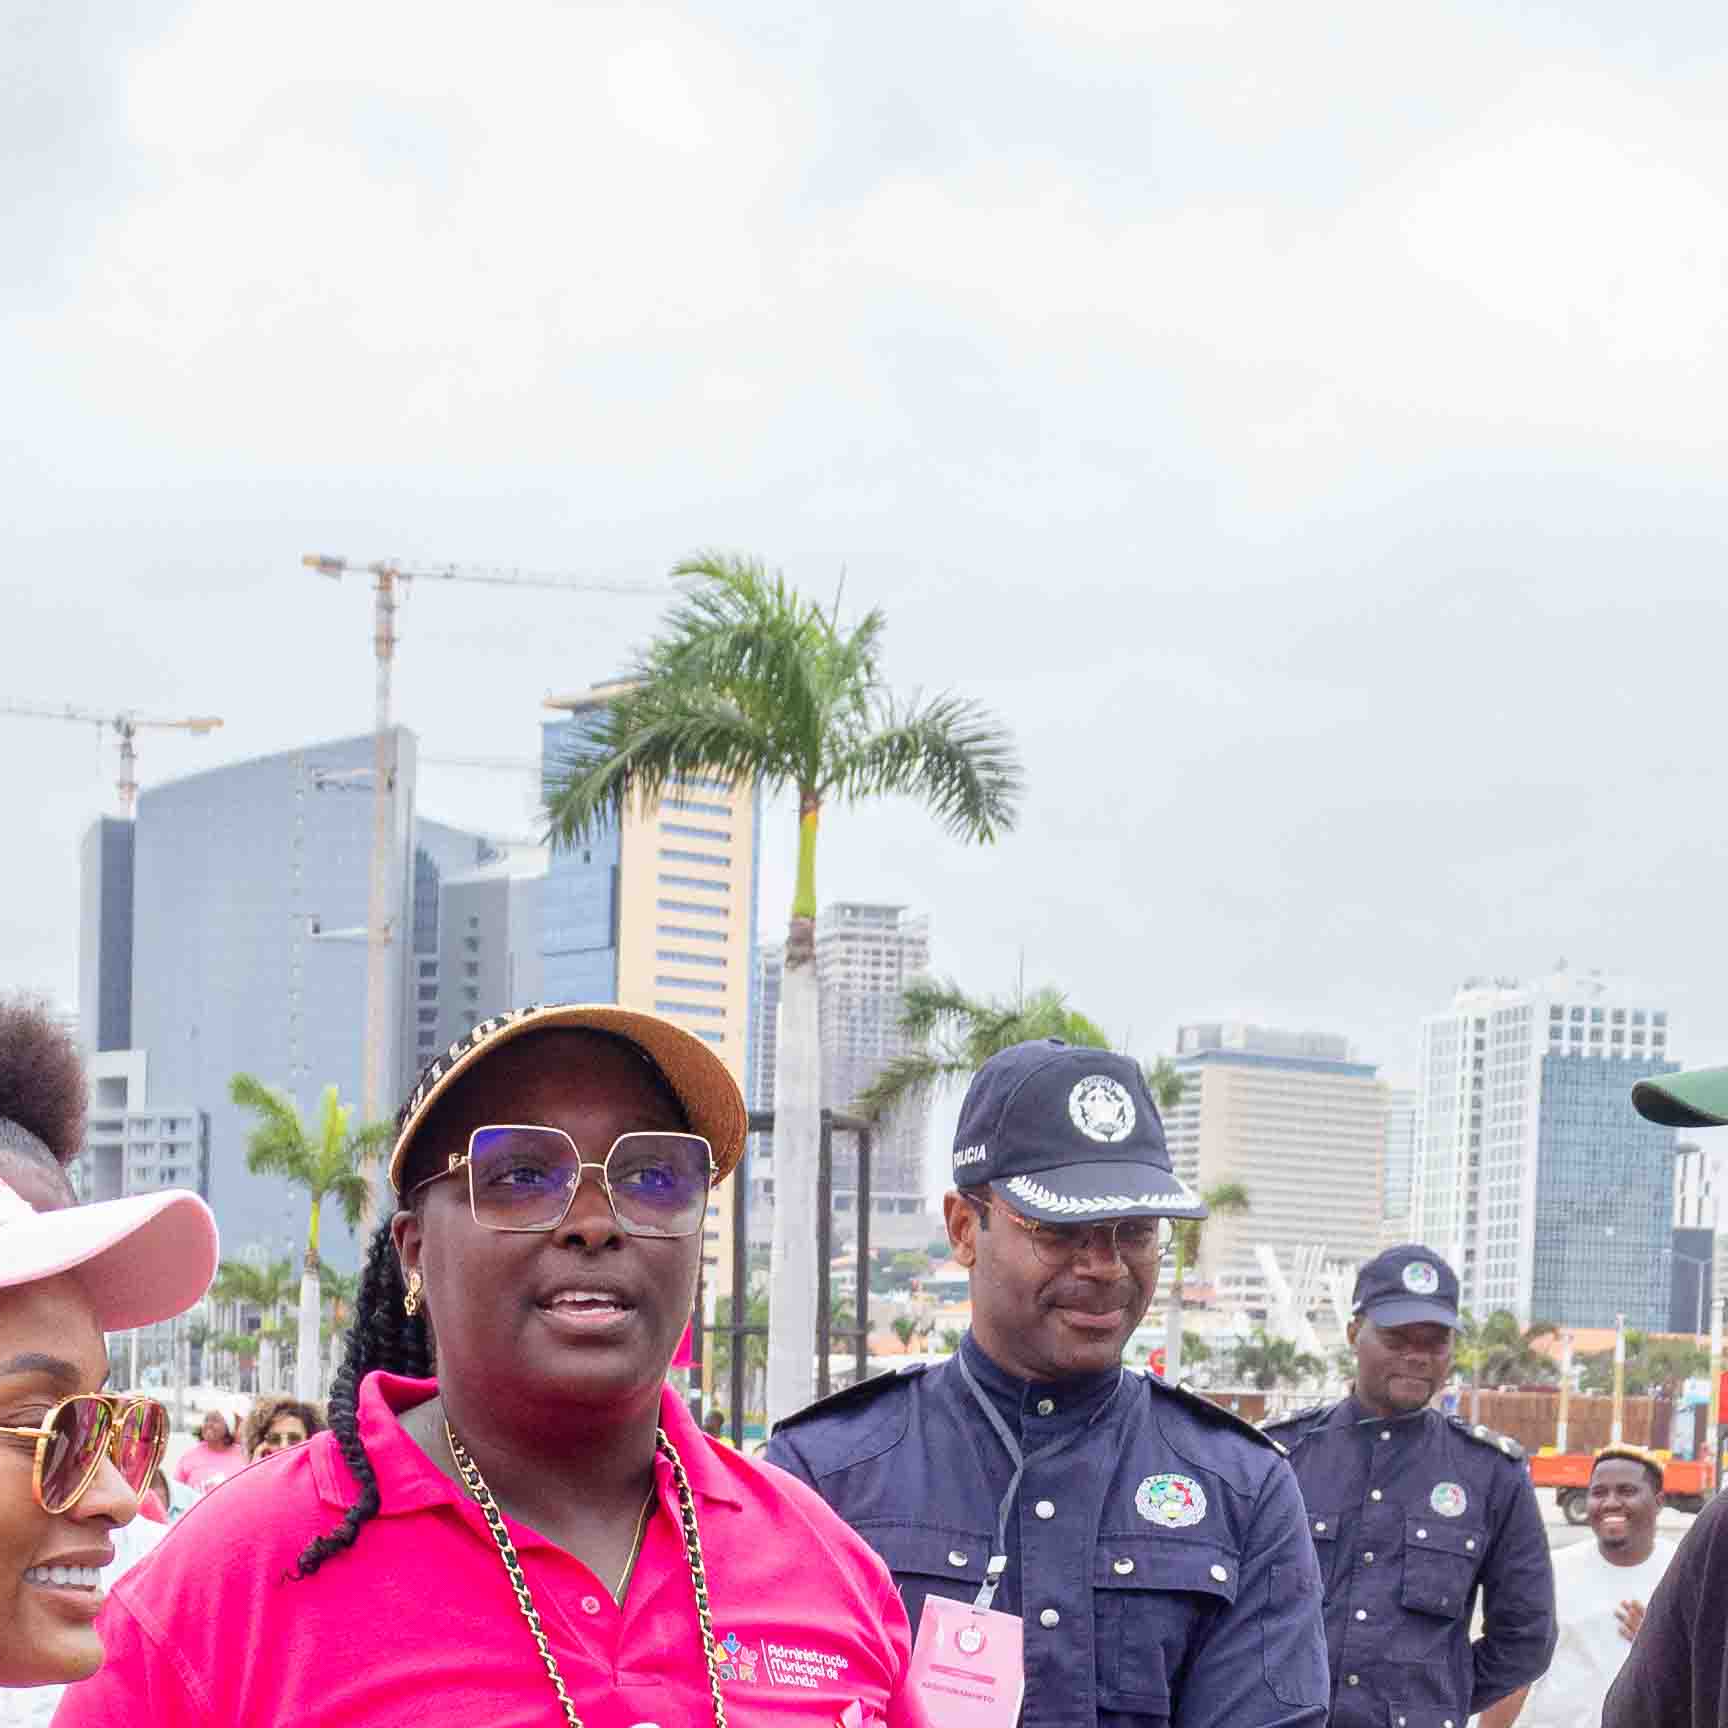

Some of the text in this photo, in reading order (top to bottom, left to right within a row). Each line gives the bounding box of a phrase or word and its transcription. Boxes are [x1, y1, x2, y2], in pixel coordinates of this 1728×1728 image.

[768, 1644, 848, 1669] Administração
[770, 1658, 839, 1680] Municipal de
[773, 1670, 818, 1688] Luanda
